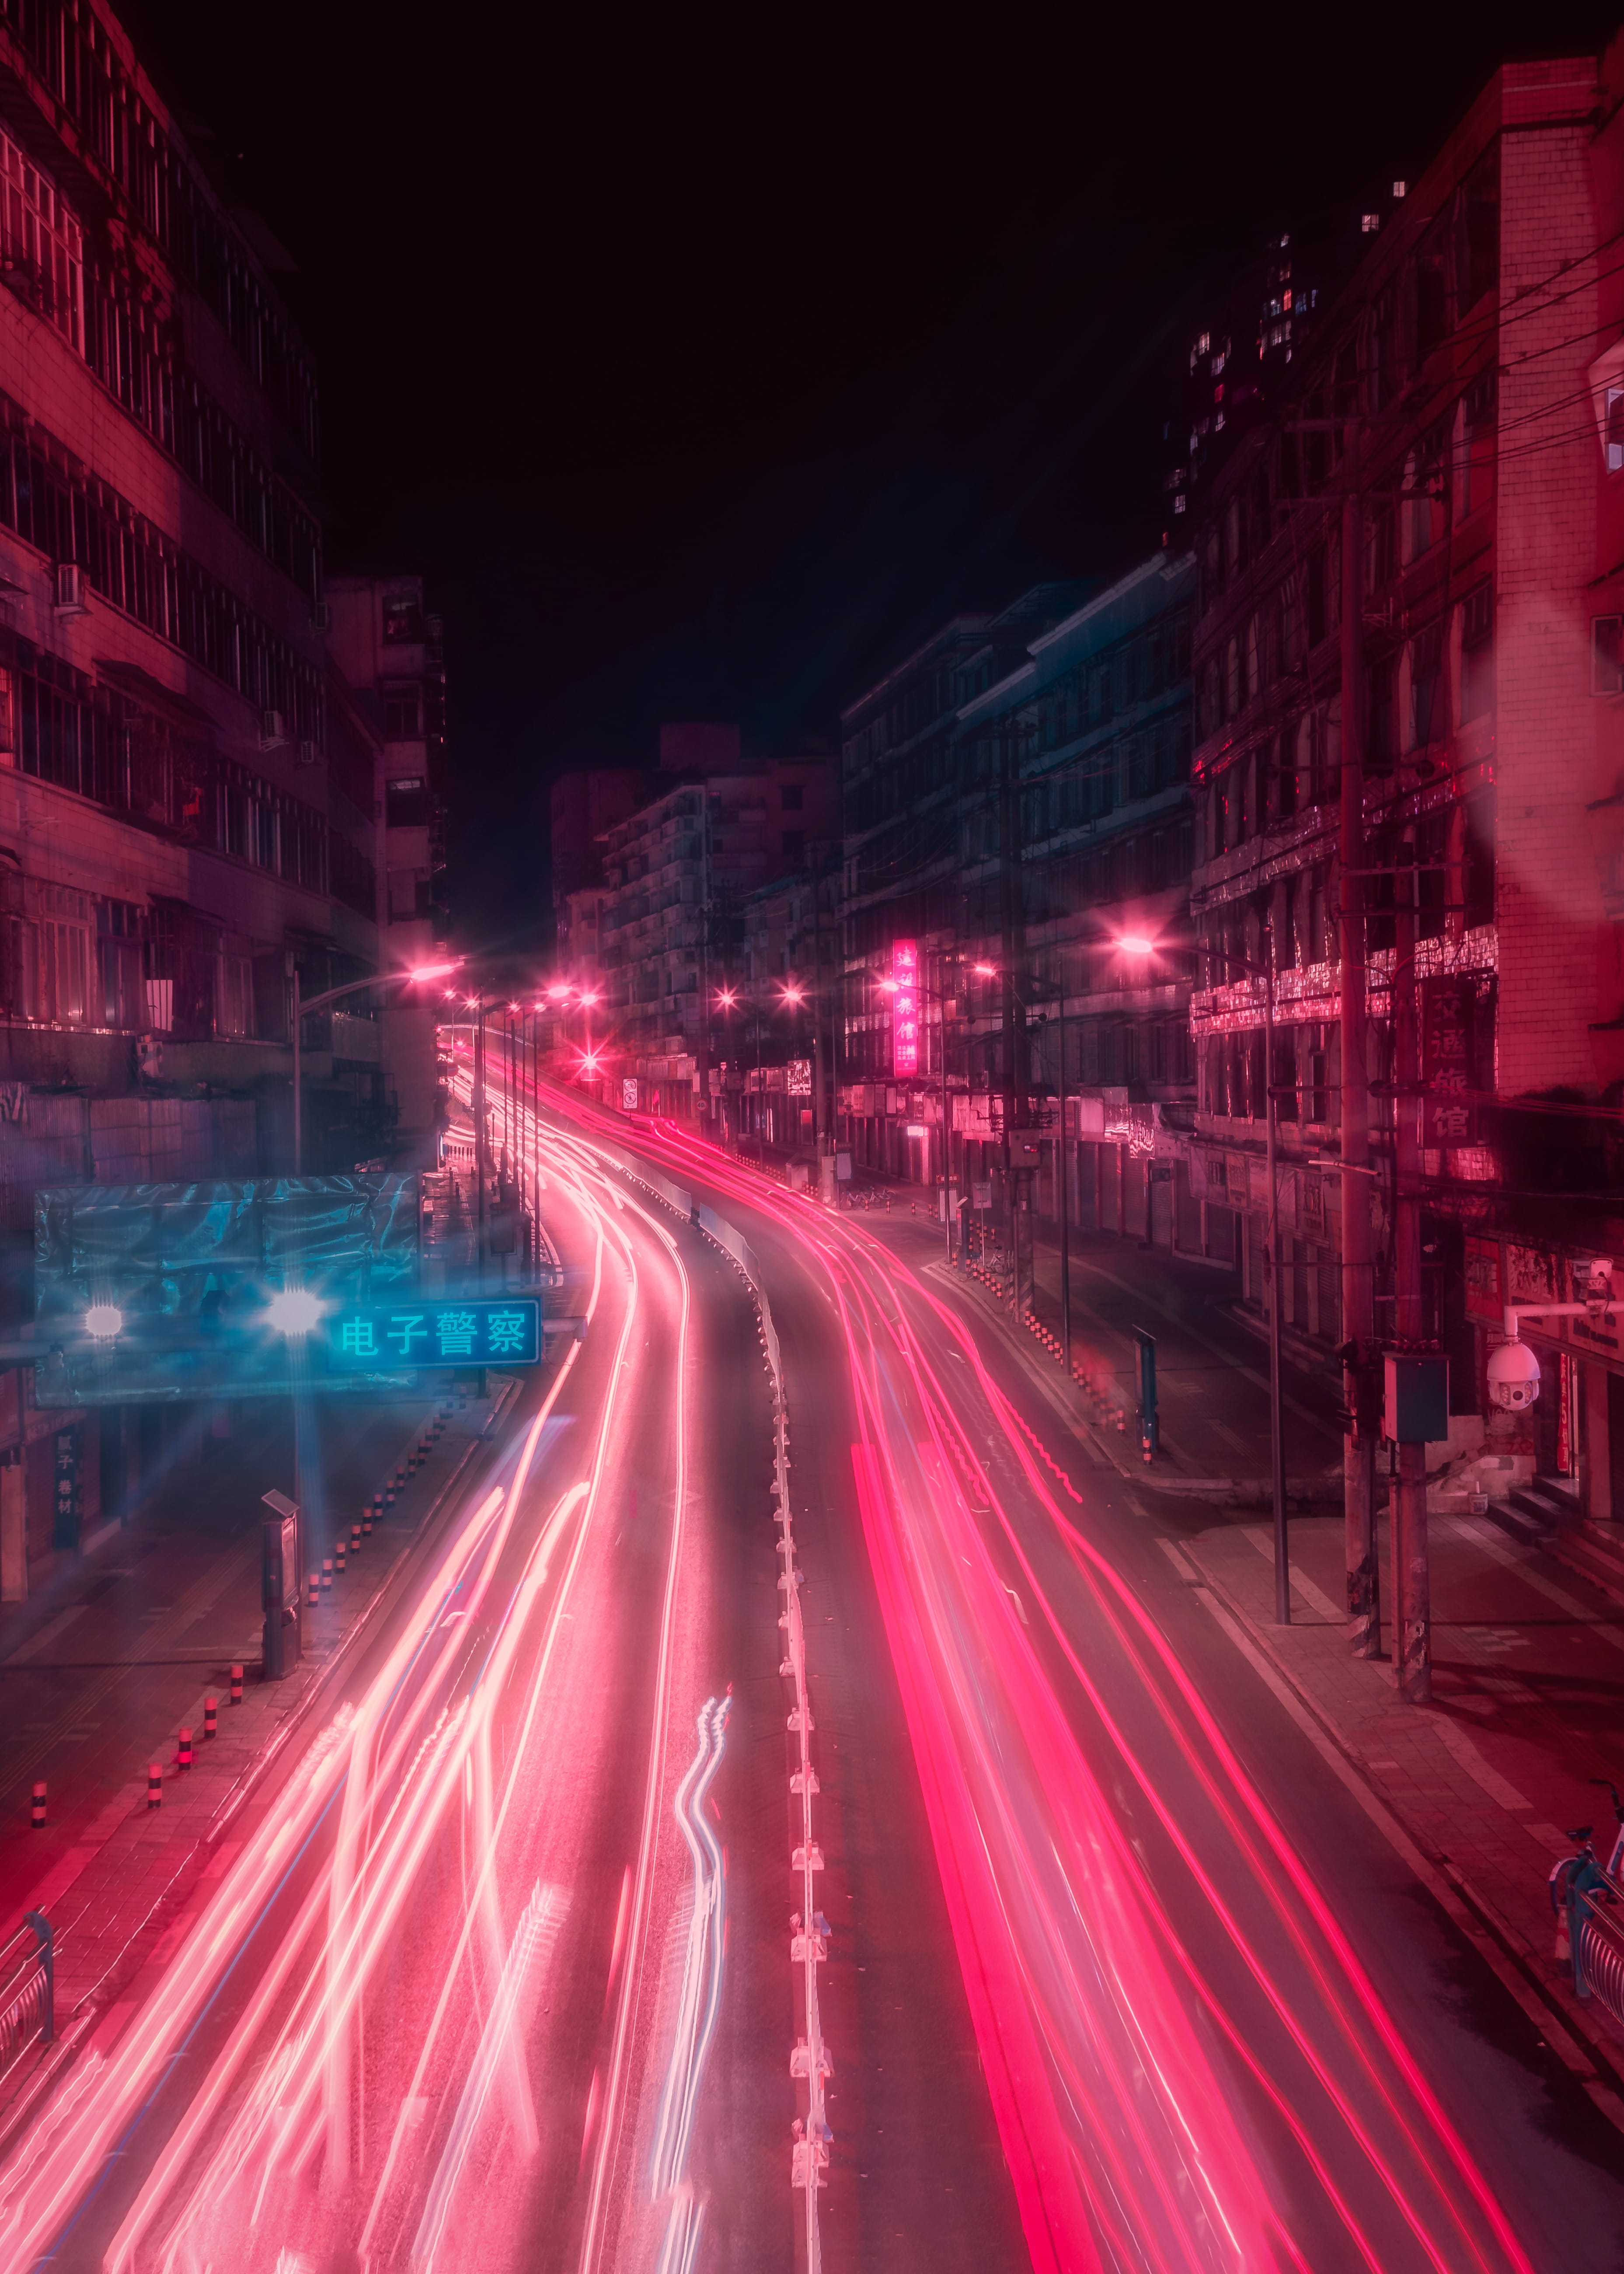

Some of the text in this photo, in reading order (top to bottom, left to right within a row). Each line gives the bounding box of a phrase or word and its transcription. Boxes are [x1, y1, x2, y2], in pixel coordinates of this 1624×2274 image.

[896, 946, 915, 1040] 建设旅馆
[1432, 990, 1469, 1138] 交通旅馆
[342, 1310, 525, 1356] 电子警察
